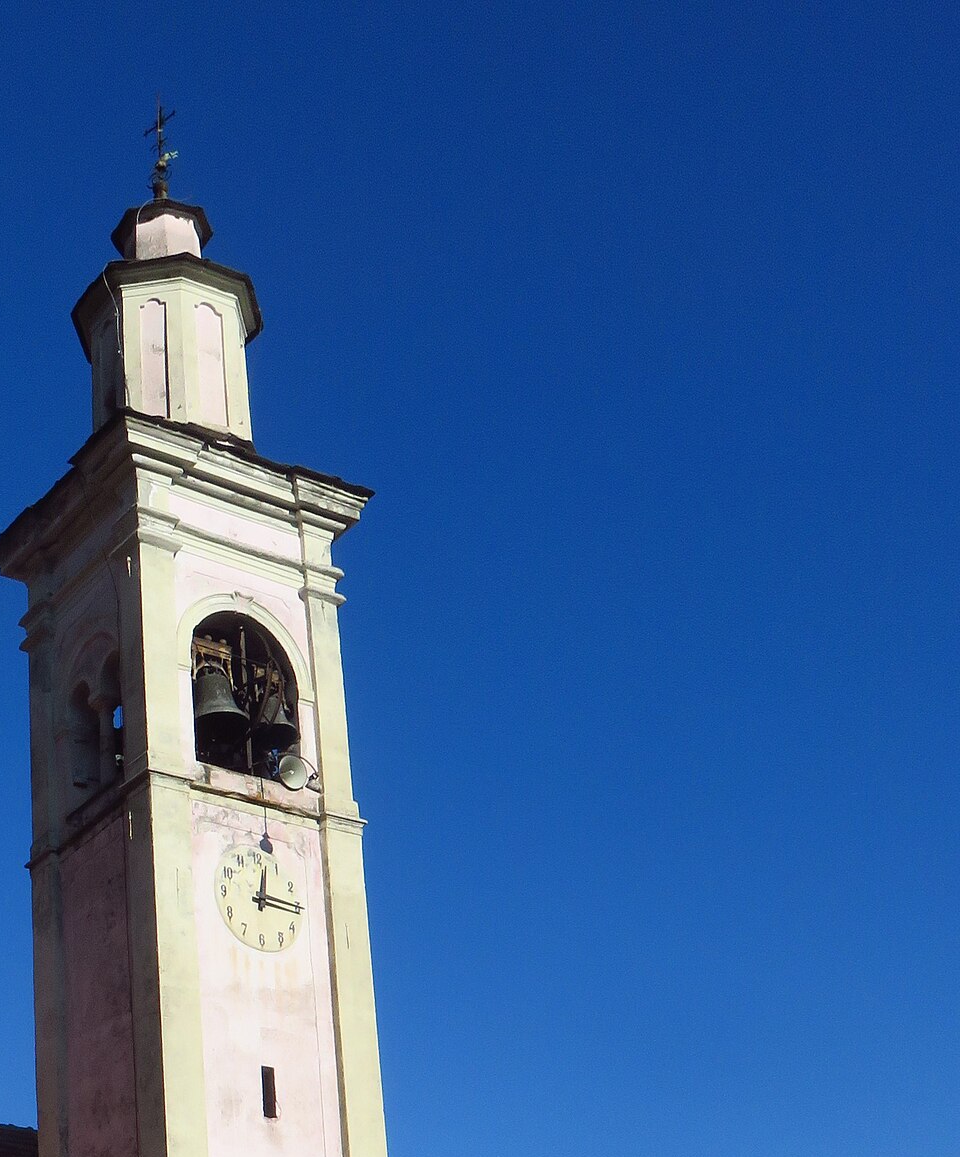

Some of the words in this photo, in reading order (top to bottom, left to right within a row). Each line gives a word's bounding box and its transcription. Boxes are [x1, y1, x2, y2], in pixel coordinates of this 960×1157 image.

[236, 854, 244, 868] 11
[252, 852, 262, 866] 12
[223, 866, 233, 880] 10
[274, 863, 278, 875] 1
[220, 884, 227, 898] 9
[288, 881, 294, 893] 2
[226, 905, 233, 921] 8
[241, 922, 247, 935] 7
[289, 921, 295, 934] 4
[259, 933, 265, 947] 6
[278, 932, 284, 947] 5
